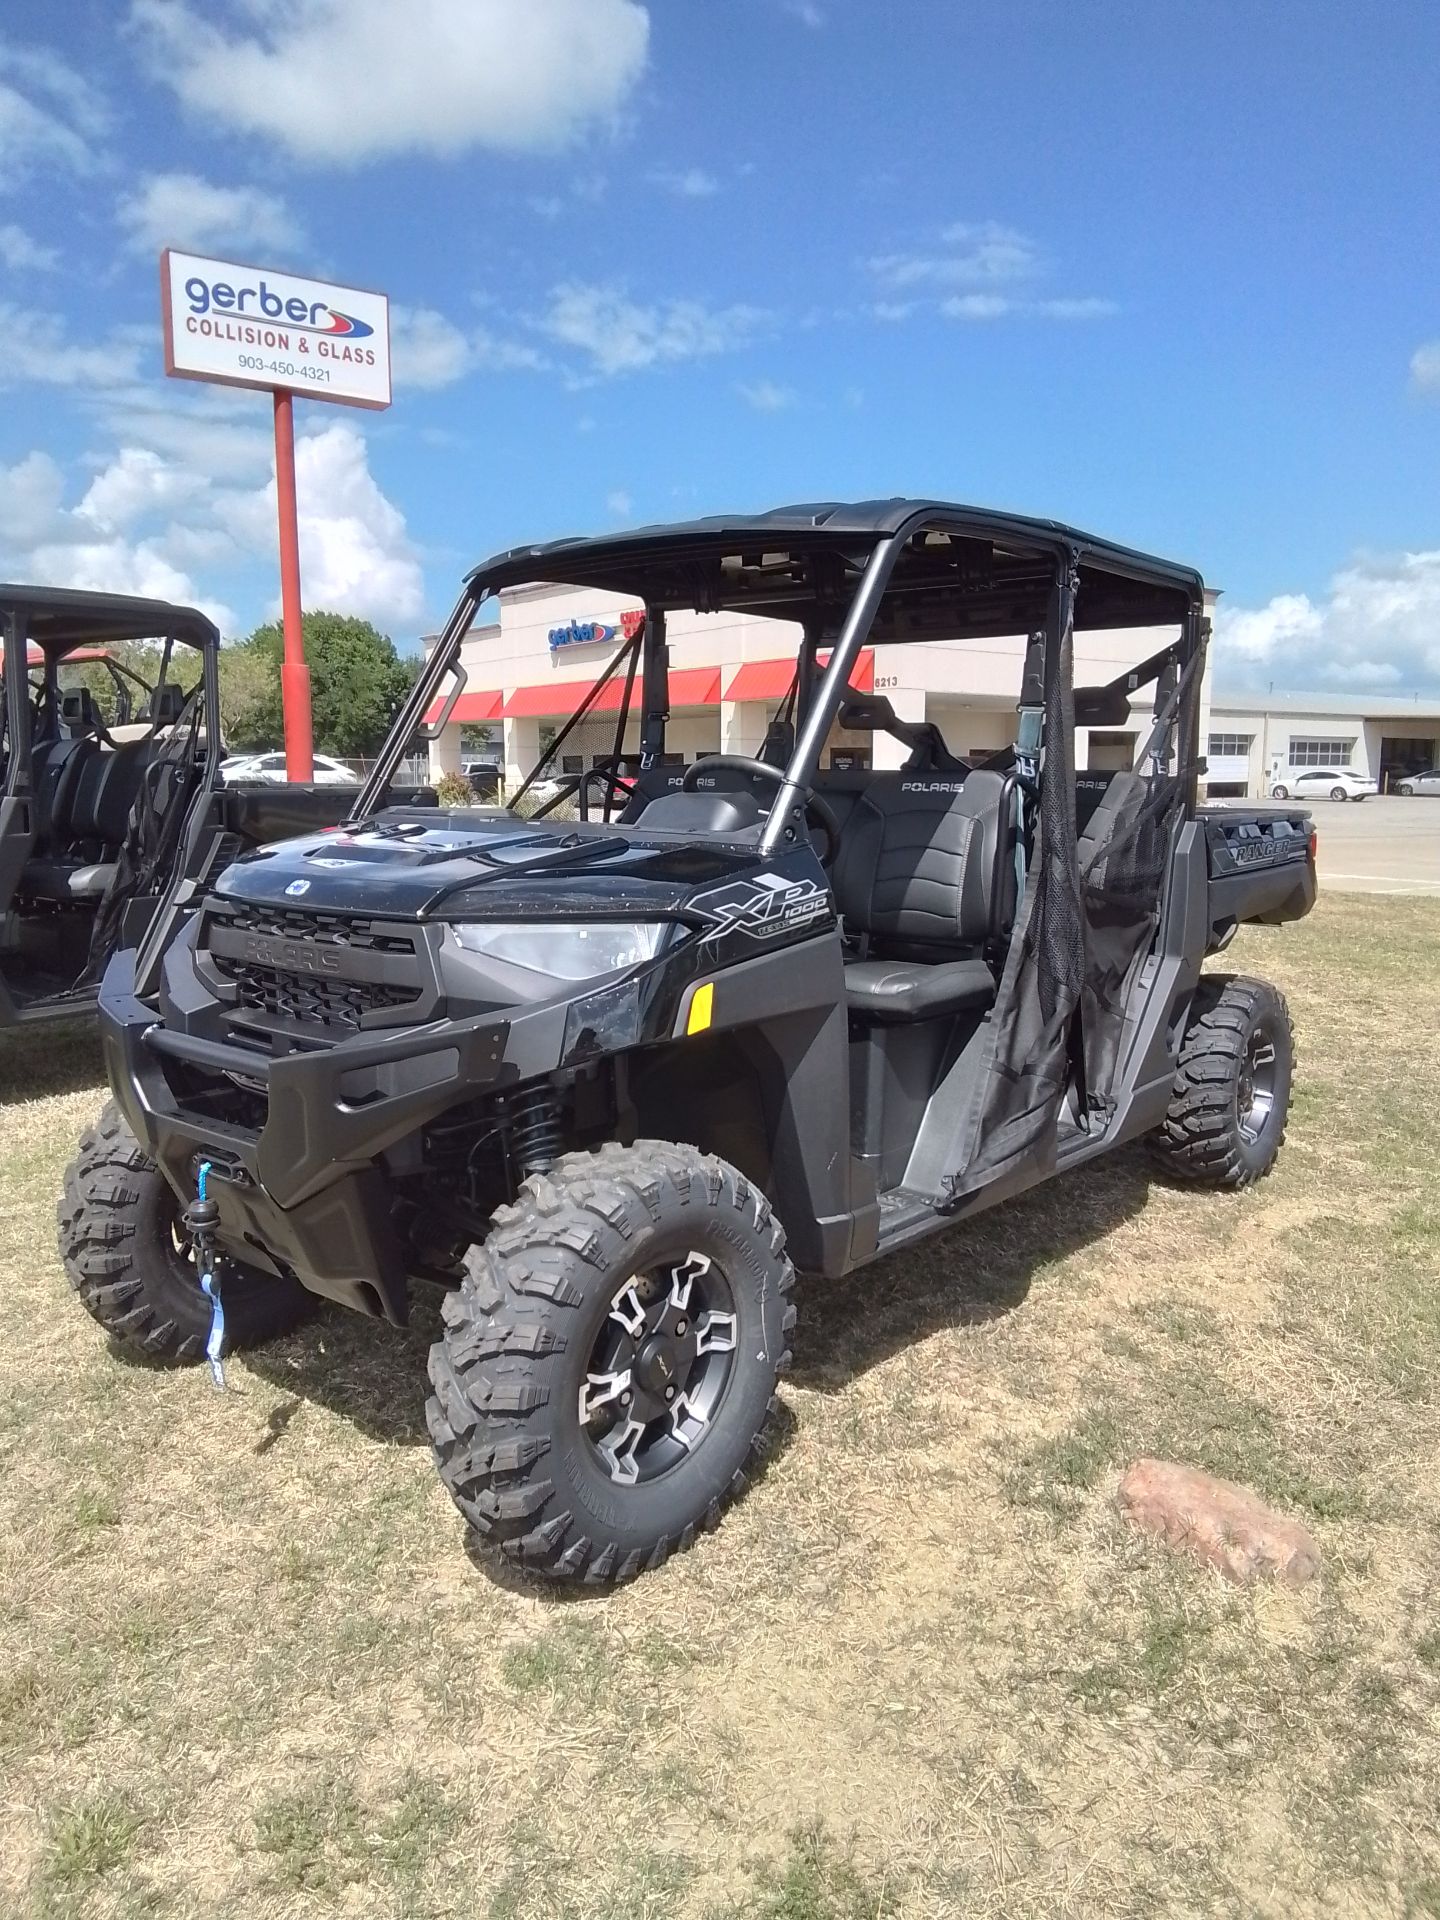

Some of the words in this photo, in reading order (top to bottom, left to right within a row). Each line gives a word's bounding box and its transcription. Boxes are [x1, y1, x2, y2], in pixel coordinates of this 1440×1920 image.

[185, 277, 329, 324] gerber
[186, 316, 290, 351] COLLISION
[298, 337, 310, 354] &
[318, 341, 376, 366] GLASS
[238, 354, 331, 383] 903-450-4321
[548, 619, 597, 651] gerber
[667, 777, 716, 788] PORIS
[900, 782, 965, 793] POLARIS
[1076, 780, 1108, 790] ARIS
[1236, 839, 1291, 862] RANGER
[785, 897, 828, 919] 1000
[245, 936, 341, 973] POLARIS
